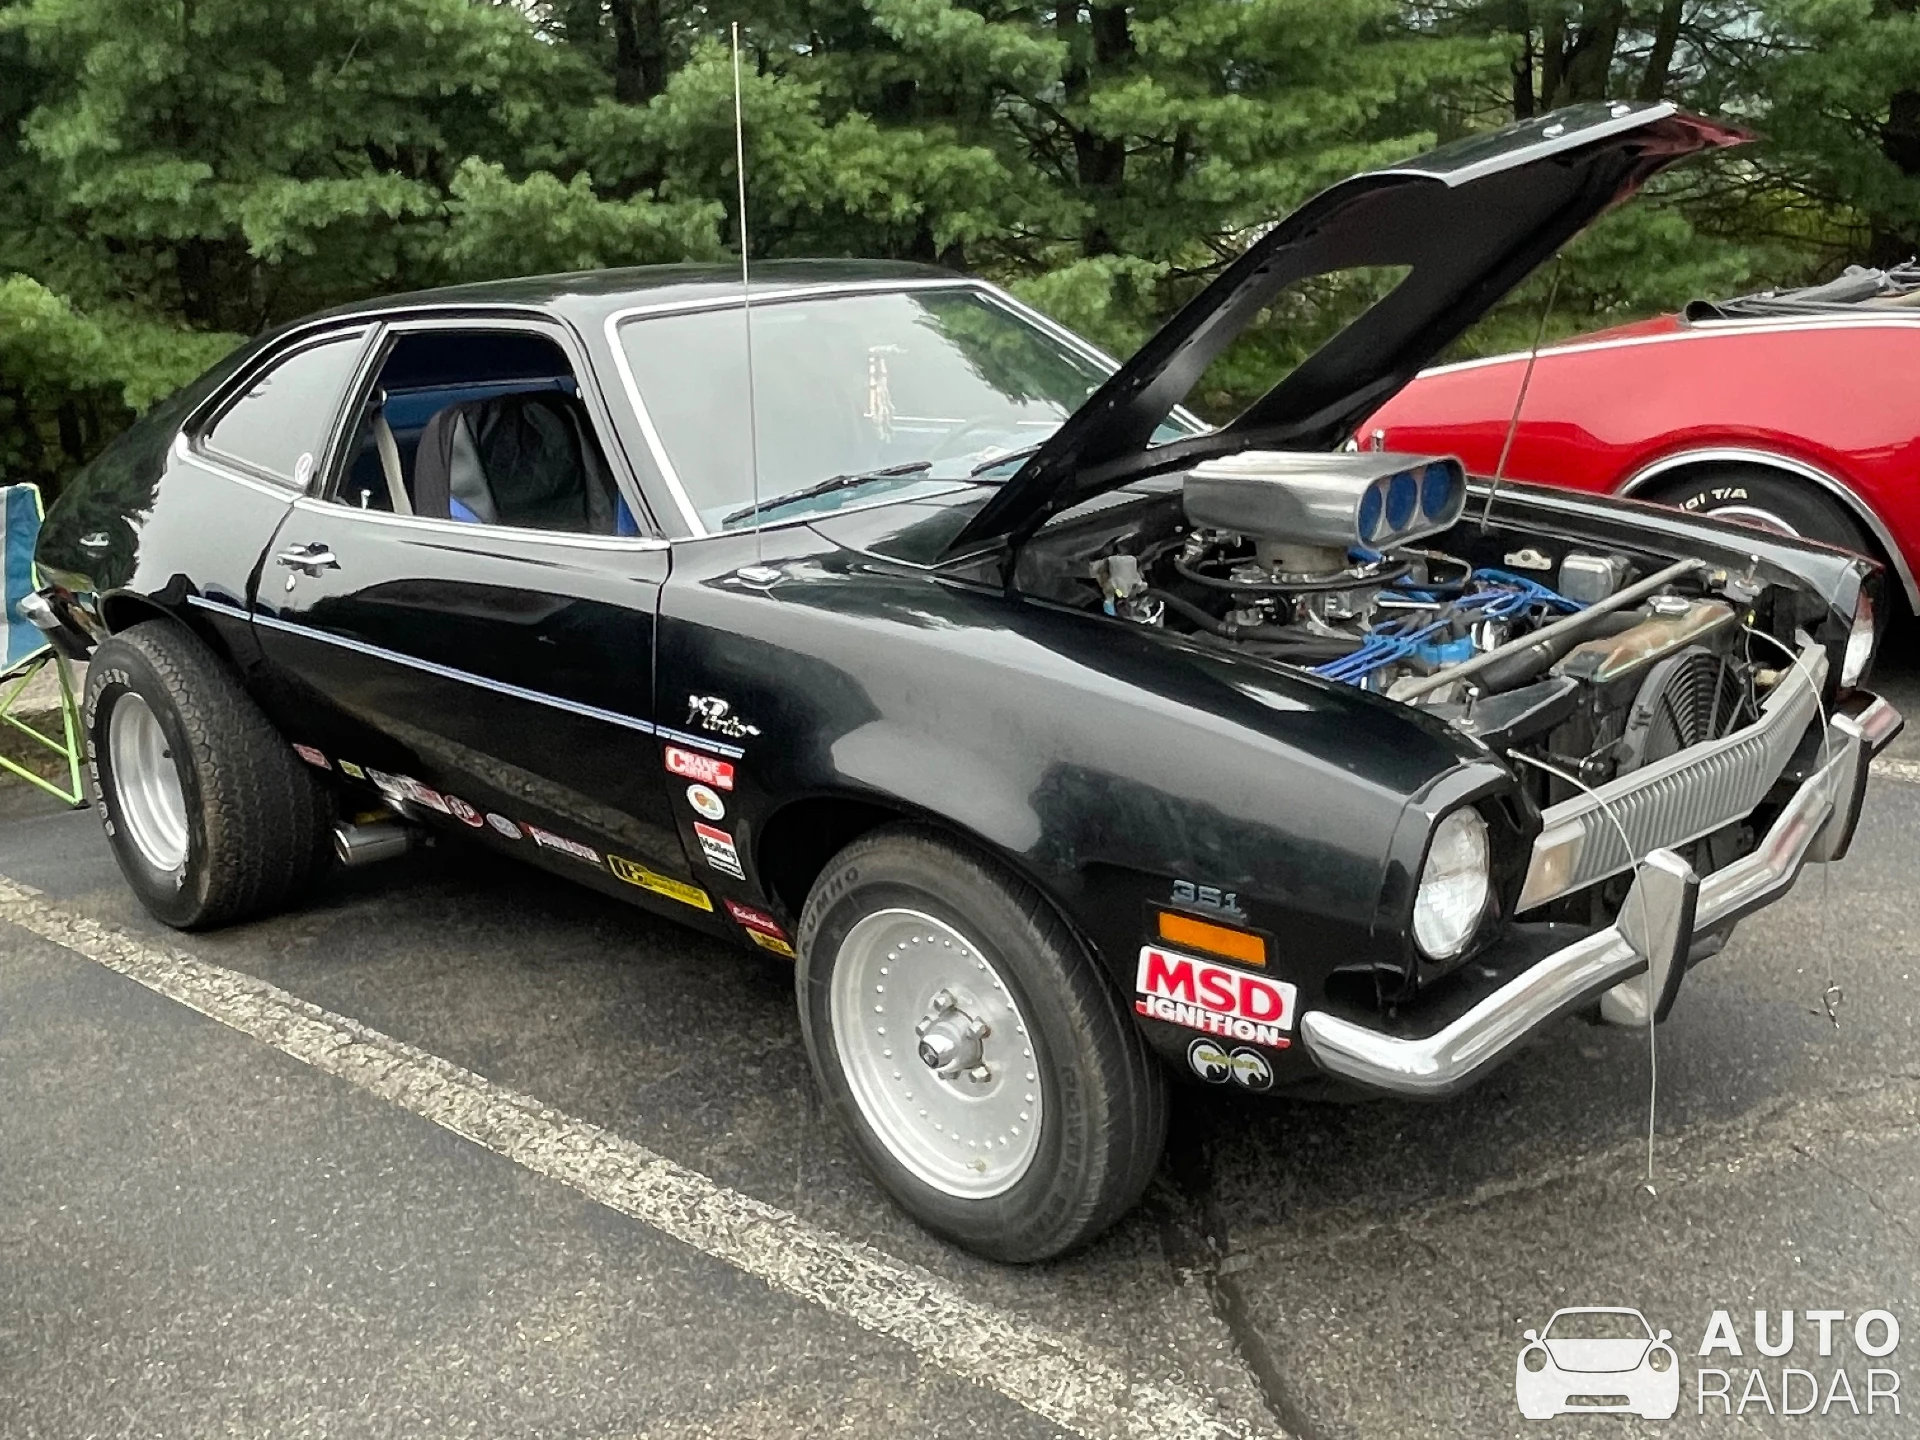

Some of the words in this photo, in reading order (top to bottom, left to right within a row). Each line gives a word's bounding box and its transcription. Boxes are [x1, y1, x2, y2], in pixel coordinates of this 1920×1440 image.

[1711, 487, 1748, 500] T/A
[1171, 879, 1243, 914] 351
[1146, 952, 1282, 1022] MSD
[1146, 995, 1280, 1046] IGNITION
